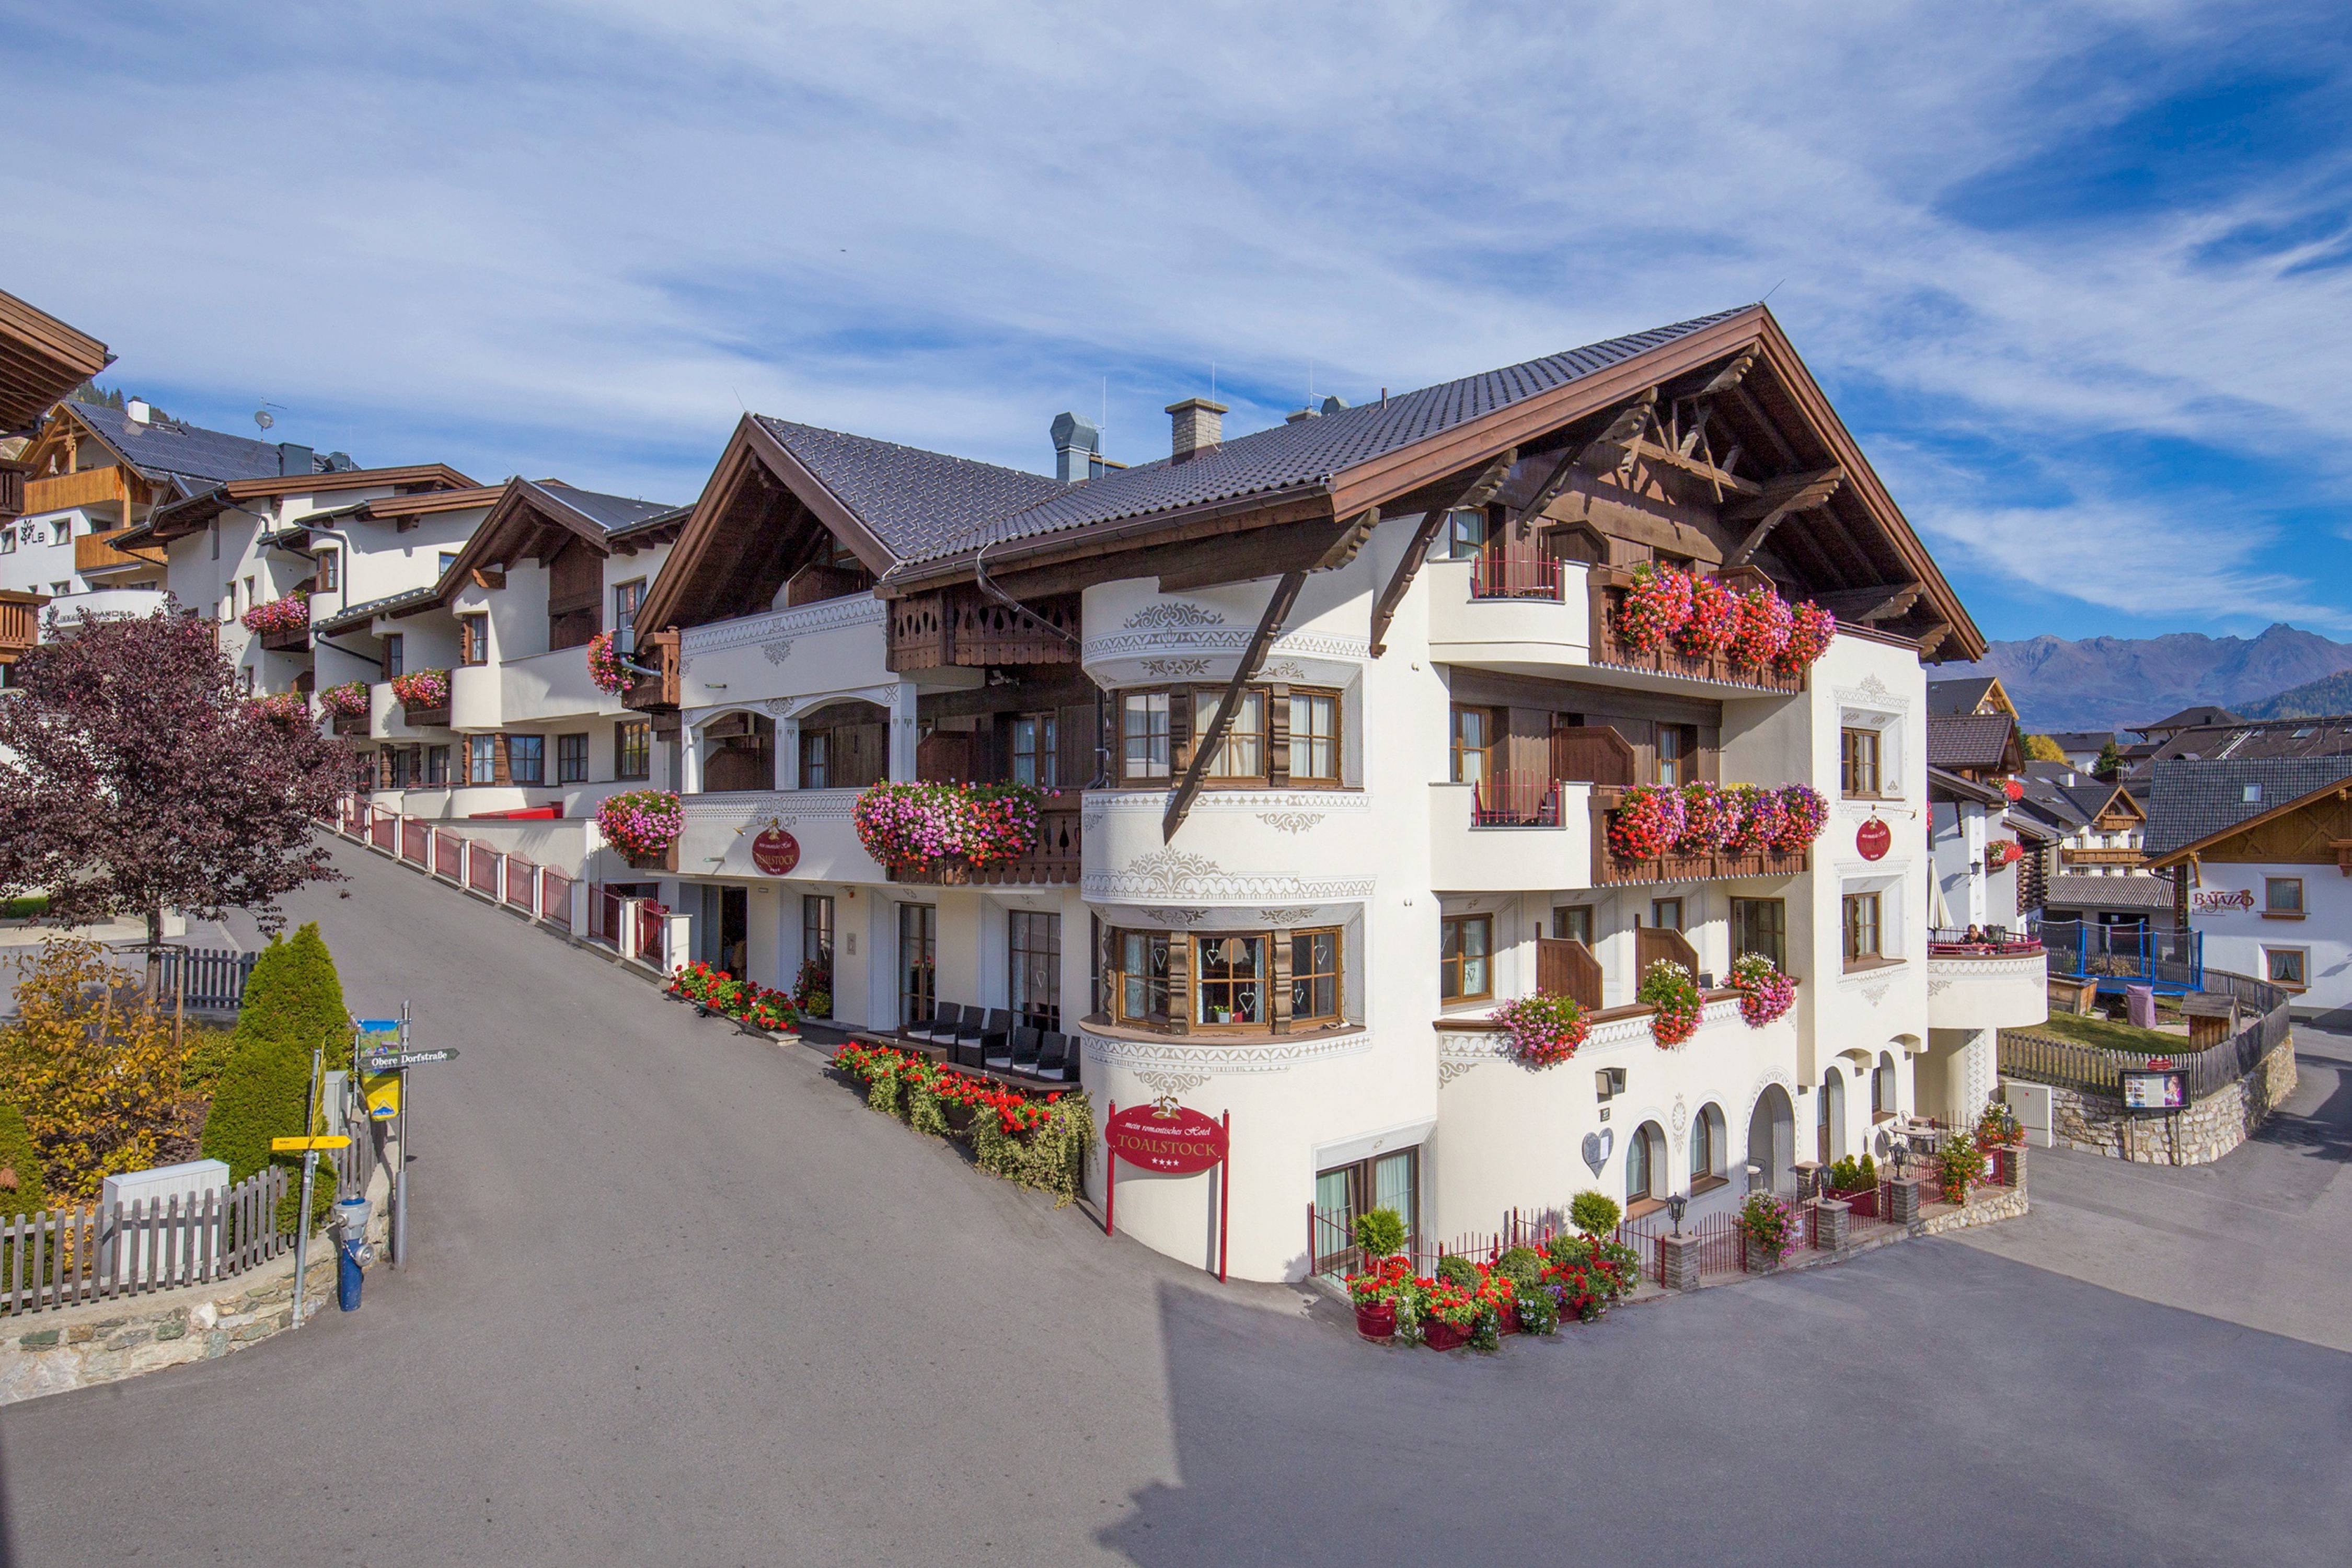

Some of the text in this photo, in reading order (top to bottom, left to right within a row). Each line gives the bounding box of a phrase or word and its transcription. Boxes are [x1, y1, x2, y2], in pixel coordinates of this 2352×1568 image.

[32, 532, 45, 544] LB
[2192, 891, 2255, 913] BAJAZZO
[372, 1051, 447, 1066] Obere Dorfstraße
[1142, 1125, 1182, 1135] romantisches
[1184, 1125, 1211, 1136] Hotel
[1117, 1134, 1217, 1157] TOALSTOCK
